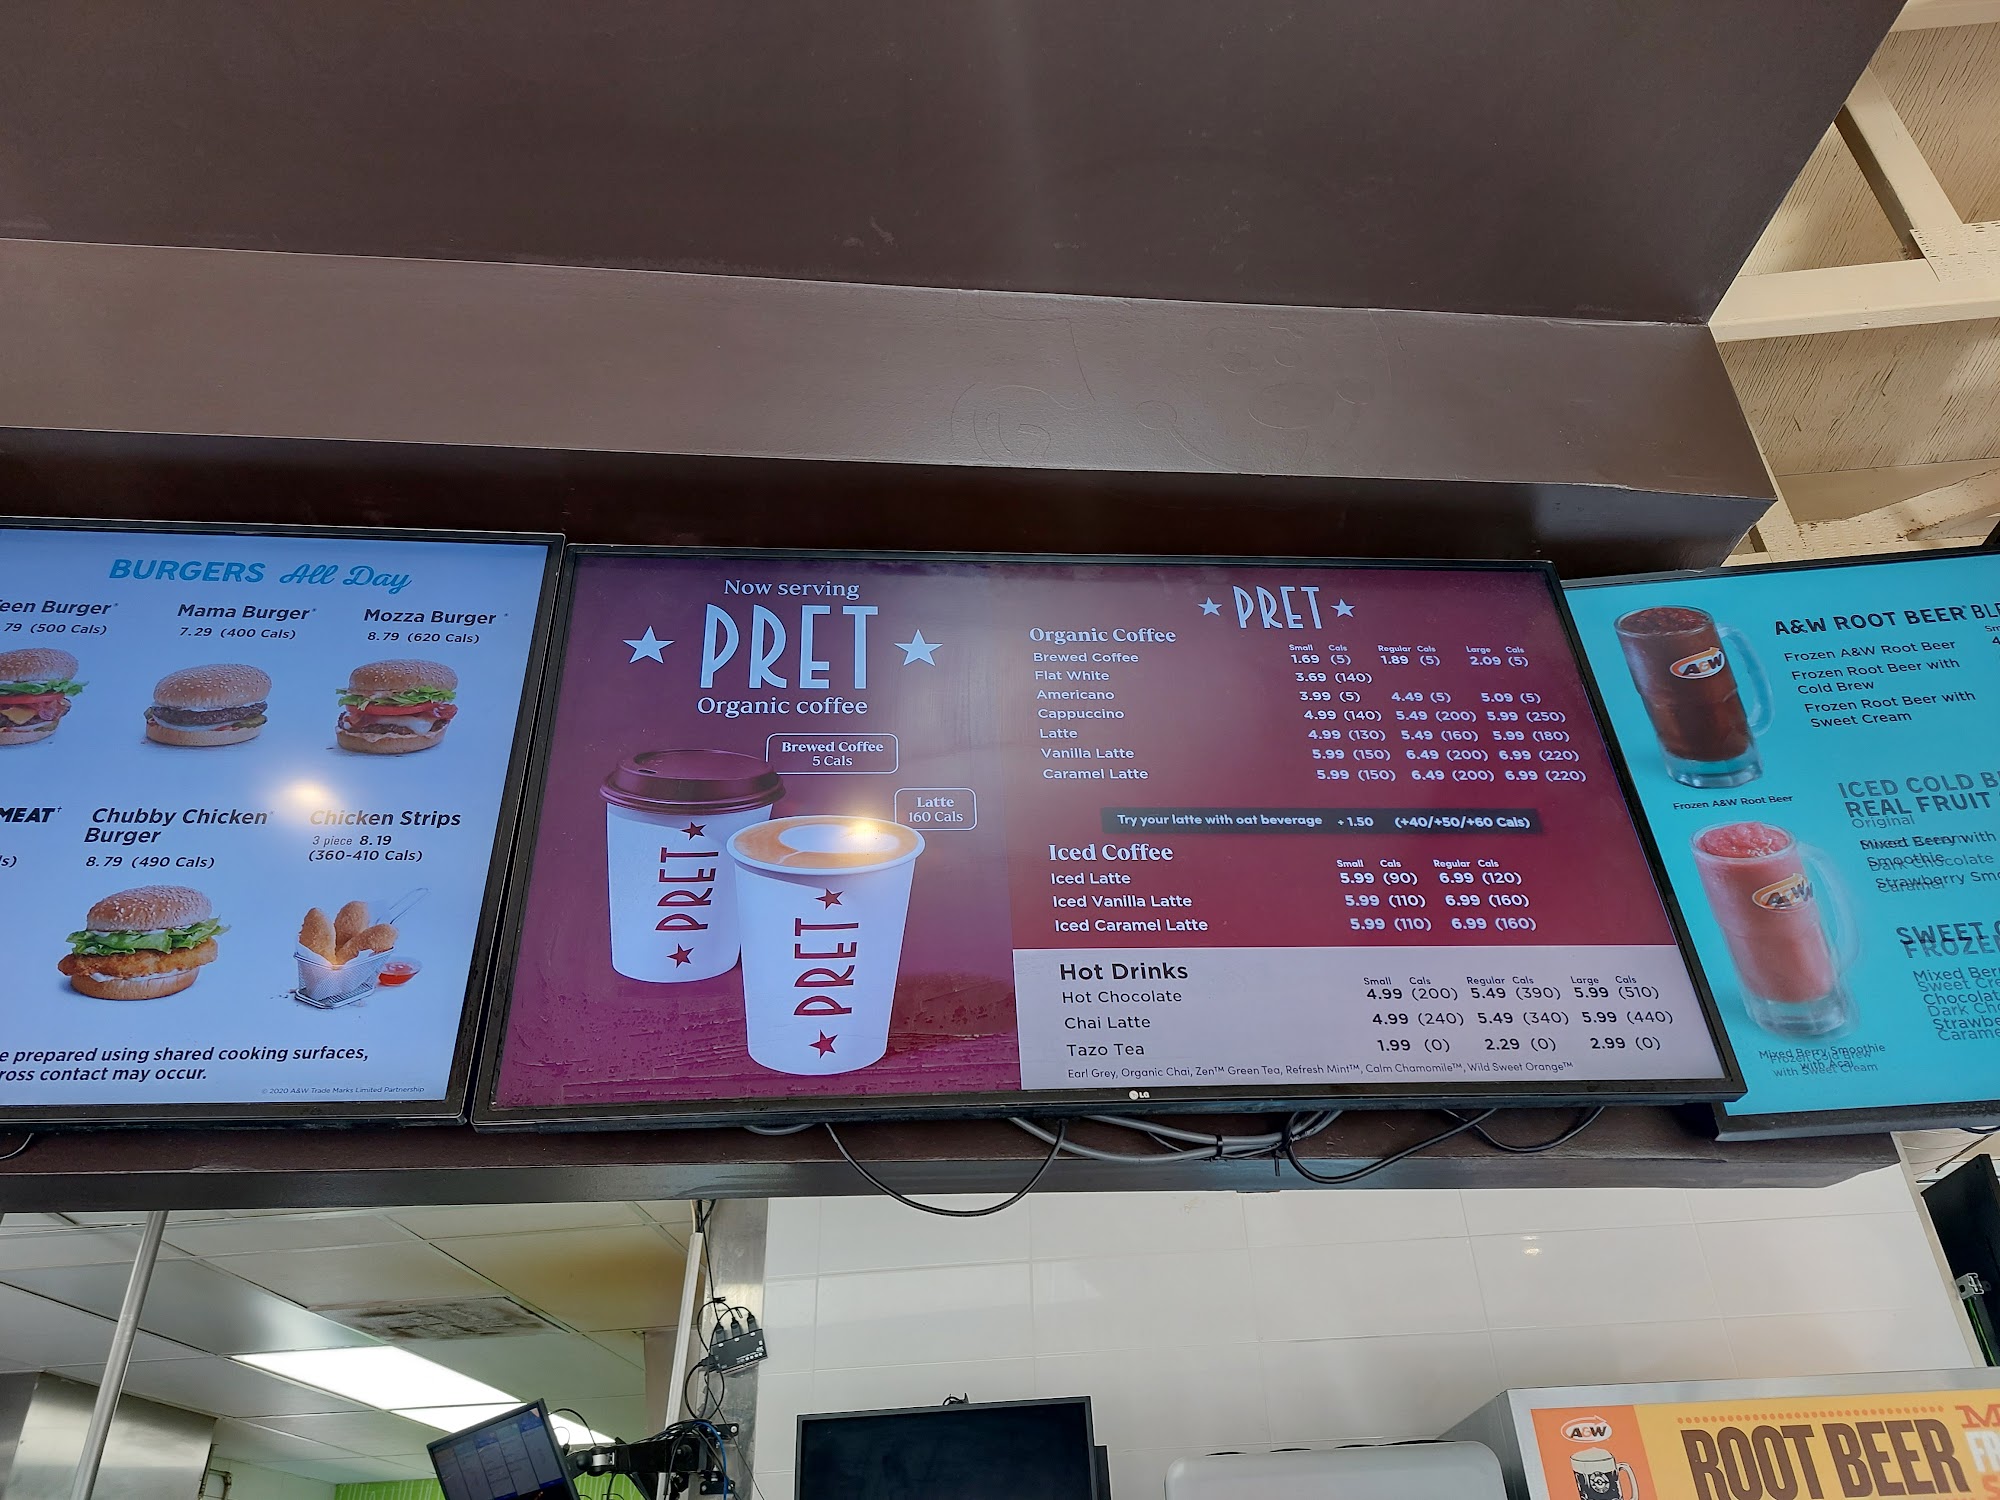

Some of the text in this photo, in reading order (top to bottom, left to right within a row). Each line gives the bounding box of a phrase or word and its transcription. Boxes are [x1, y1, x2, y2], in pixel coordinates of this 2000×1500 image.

[109, 558, 412, 595] BURGERS All Day
[725, 580, 859, 600] Now serving
[177, 604, 236, 618] Mama
[1232, 585, 1322, 629] PRET
[364, 608, 425, 623] Mozza
[30, 623, 66, 634] (500
[71, 624, 107, 636] Cals)
[1775, 617, 1827, 635] A&W
[1833, 612, 1896, 630] ROOT
[179, 627, 296, 640] 7.29 (400 Cals)
[367, 632, 480, 645] 8.79 (620 Cals)
[1029, 627, 1177, 645] Organic Coffee
[700, 603, 879, 689] PRET
[1784, 640, 1956, 662] Frozen A&W Root Beer
[1033, 652, 1139, 663] Brewed Coffee
[1681, 654, 1722, 676] A&W
[1035, 670, 1110, 681] Flat White
[1791, 658, 1960, 680] Frozen Root Beer with
[1295, 671, 1373, 684] 3.69 (140)
[1036, 689, 1115, 700] Americano
[1797, 680, 1875, 695] Cold Brew
[698, 697, 868, 718] Organic coffee
[1804, 690, 1976, 713] Frozen Root Beer with
[1038, 708, 1125, 720] Cappuccino
[1810, 711, 1912, 728] Sweet Cream
[1039, 728, 1078, 739] Latte
[782, 741, 884, 752] Brewed Coffee
[1041, 748, 1135, 759] Vanilla Latte
[812, 755, 853, 767] 5 Cals
[1043, 769, 1149, 780] Caramel Latte
[1838, 779, 1899, 799] ICED
[1905, 774, 1974, 794] COLD
[917, 796, 955, 808] Latte
[1673, 795, 1793, 810] Frozen A&W Root Beer
[1845, 792, 1991, 818] REAL FRUIT
[92, 807, 176, 827] Chubby
[310, 809, 461, 829] Chicken Strips
[909, 811, 964, 823] 160 Cals
[1117, 814, 1530, 829] Try your latte with oat beverage 1.50 (+40/+50/+60 Cals)
[1852, 815, 1915, 829] Original
[84, 827, 161, 846] Burger
[312, 834, 392, 848] 3 piece 8.19
[308, 850, 423, 862] (360-410 Cals)
[1049, 843, 1174, 861] Iced Coffee
[85, 856, 215, 869] 8.79 (490 Cals)
[1051, 872, 1131, 885] Iced Latte
[1340, 871, 1522, 885] 5.99 (90) 6.99 (120)
[655, 847, 719, 931] PRET
[1053, 895, 1192, 908] Iced Vanilla Latte
[1055, 919, 1208, 932] Iced Caramel Latte
[1896, 922, 1983, 945] SWEET
[793, 918, 859, 1016] PRET
[1060, 963, 1188, 980] Hot Drinks
[1913, 967, 1964, 982] Mixed
[1917, 980, 1971, 993] Sweet
[1062, 990, 1182, 1003] Hot Chocolate
[1927, 1004, 1970, 1017] Dark
[1064, 1016, 1151, 1029] Chai Latte
[13, 1046, 369, 1064] prepared using shared cooking surfaces,
[1067, 1043, 1144, 1056] Tazo Tea
[40, 1067, 207, 1082] contact may occur.
[1068, 1068, 1088, 1079] Earl
[1091, 1069, 1119, 1080] Grey,
[1121, 1067, 1163, 1079] Organic
[1166, 1067, 1193, 1077] Chai,
[1228, 1065, 1260, 1076] Green
[1262, 1065, 1283, 1077] Tea,
[1286, 1064, 1324, 1075] Refresh
[1366, 1062, 1392, 1073] Calm
[1468, 1061, 1490, 1072] Wild
[1492, 1061, 1523, 1072] Sweet
[1570, 1426, 1607, 1438] A&W
[1681, 1424, 1824, 1500] ROOT
[1822, 1418, 1972, 1497] BEER
